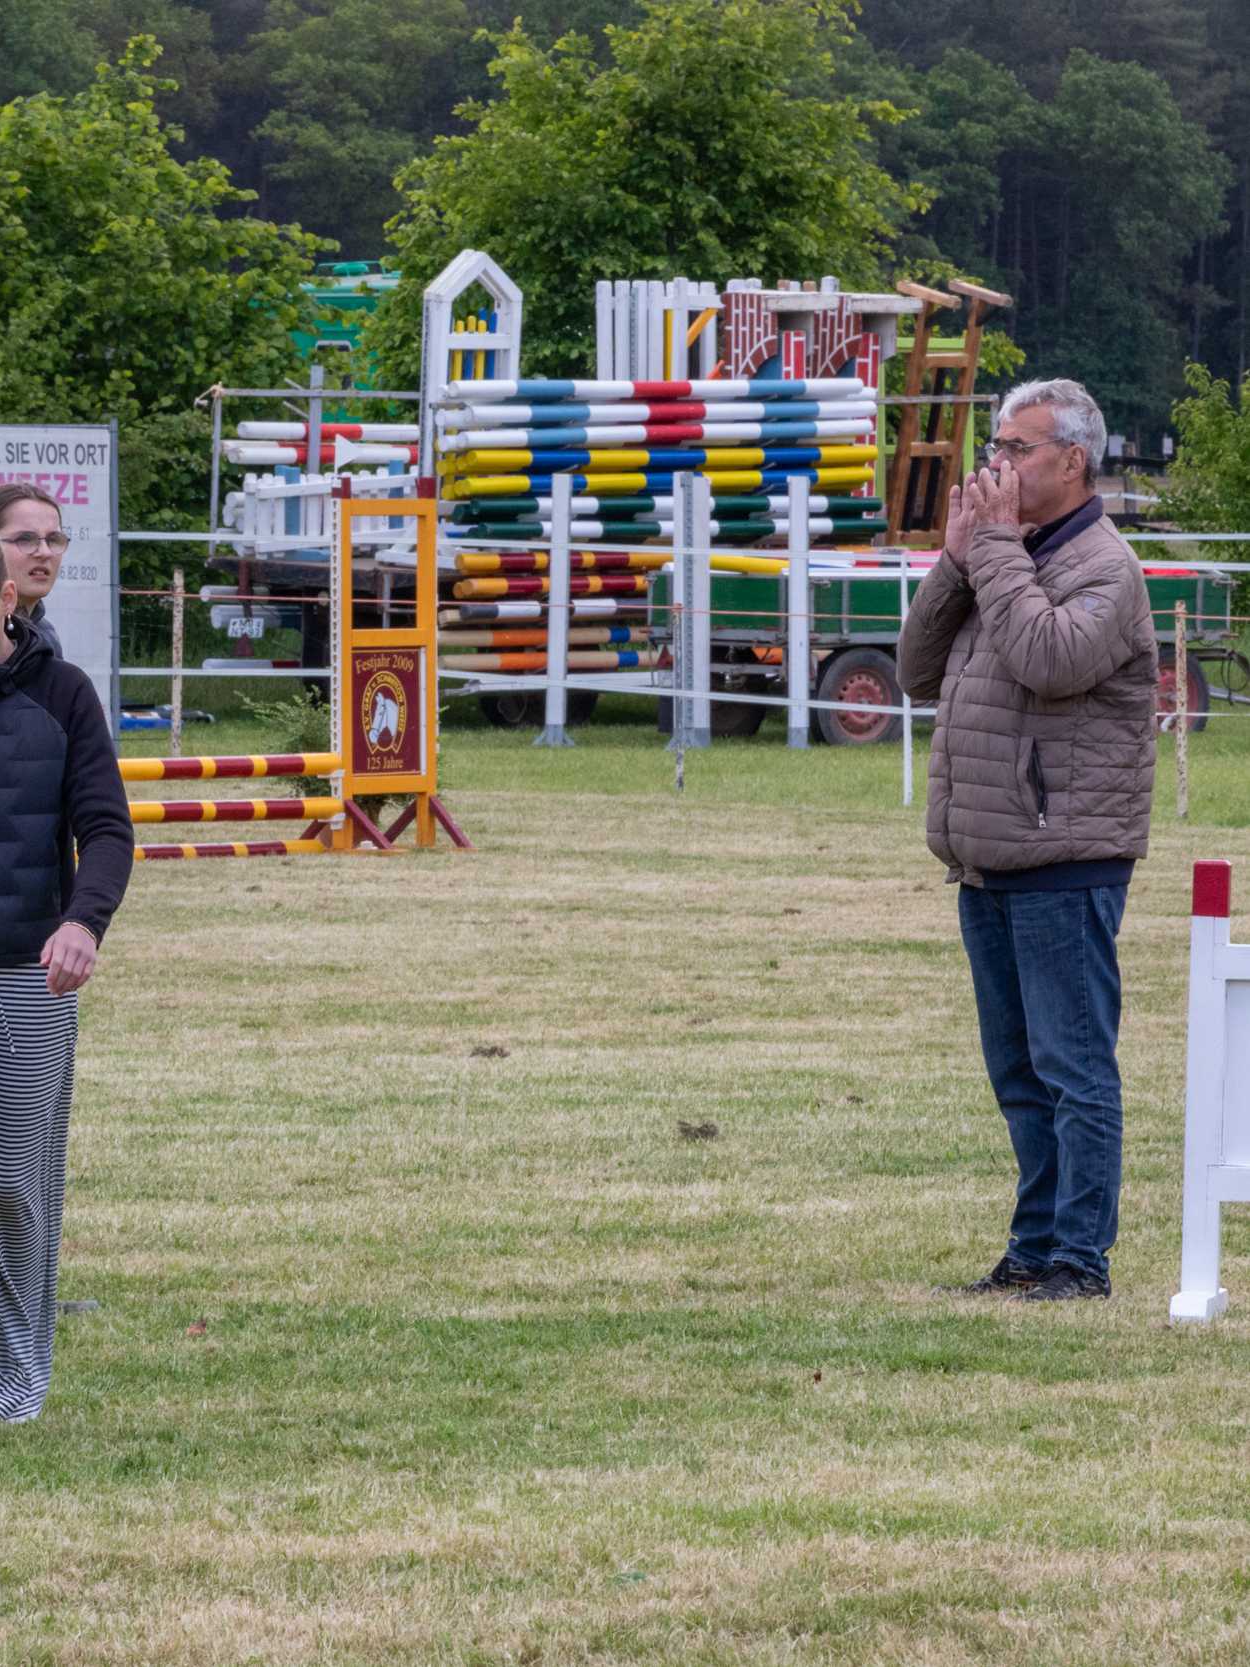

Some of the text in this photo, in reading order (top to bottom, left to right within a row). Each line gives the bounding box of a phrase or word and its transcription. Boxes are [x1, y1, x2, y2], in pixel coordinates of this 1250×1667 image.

[5, 442, 30, 464] SIE
[34, 443, 69, 465] VOR
[74, 444, 108, 466] ORT
[80, 566, 97, 581] 820
[355, 654, 414, 675] Festjahr 2009
[366, 755, 405, 770] 125 Jahre
